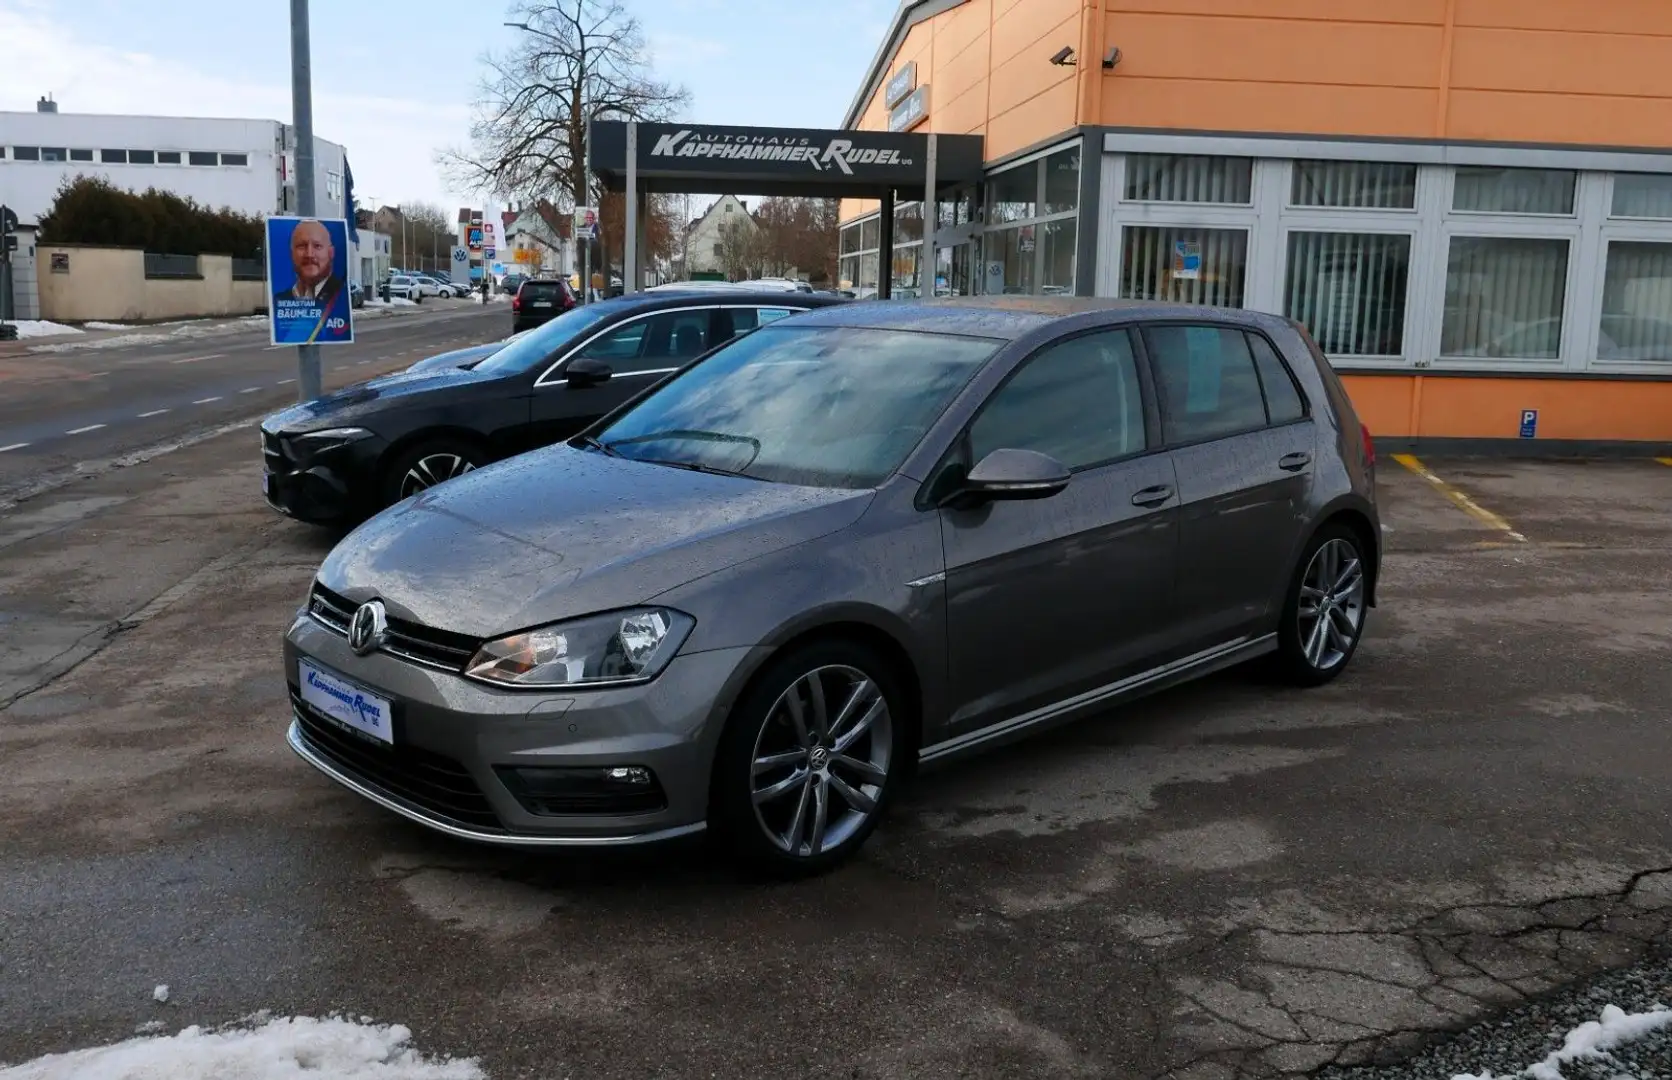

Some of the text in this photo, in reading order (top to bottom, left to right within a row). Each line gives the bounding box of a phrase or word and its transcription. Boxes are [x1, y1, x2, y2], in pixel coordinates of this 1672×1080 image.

[689, 133, 809, 146] AUTOHAUS
[651, 130, 822, 171] KAPFHAMMER
[820, 139, 901, 175] RUDEL
[902, 158, 913, 166] UG
[277, 308, 322, 318] BÄUMLER
[326, 318, 345, 329] AfD
[1524, 411, 1535, 425] P
[353, 694, 381, 722] RUDEL
